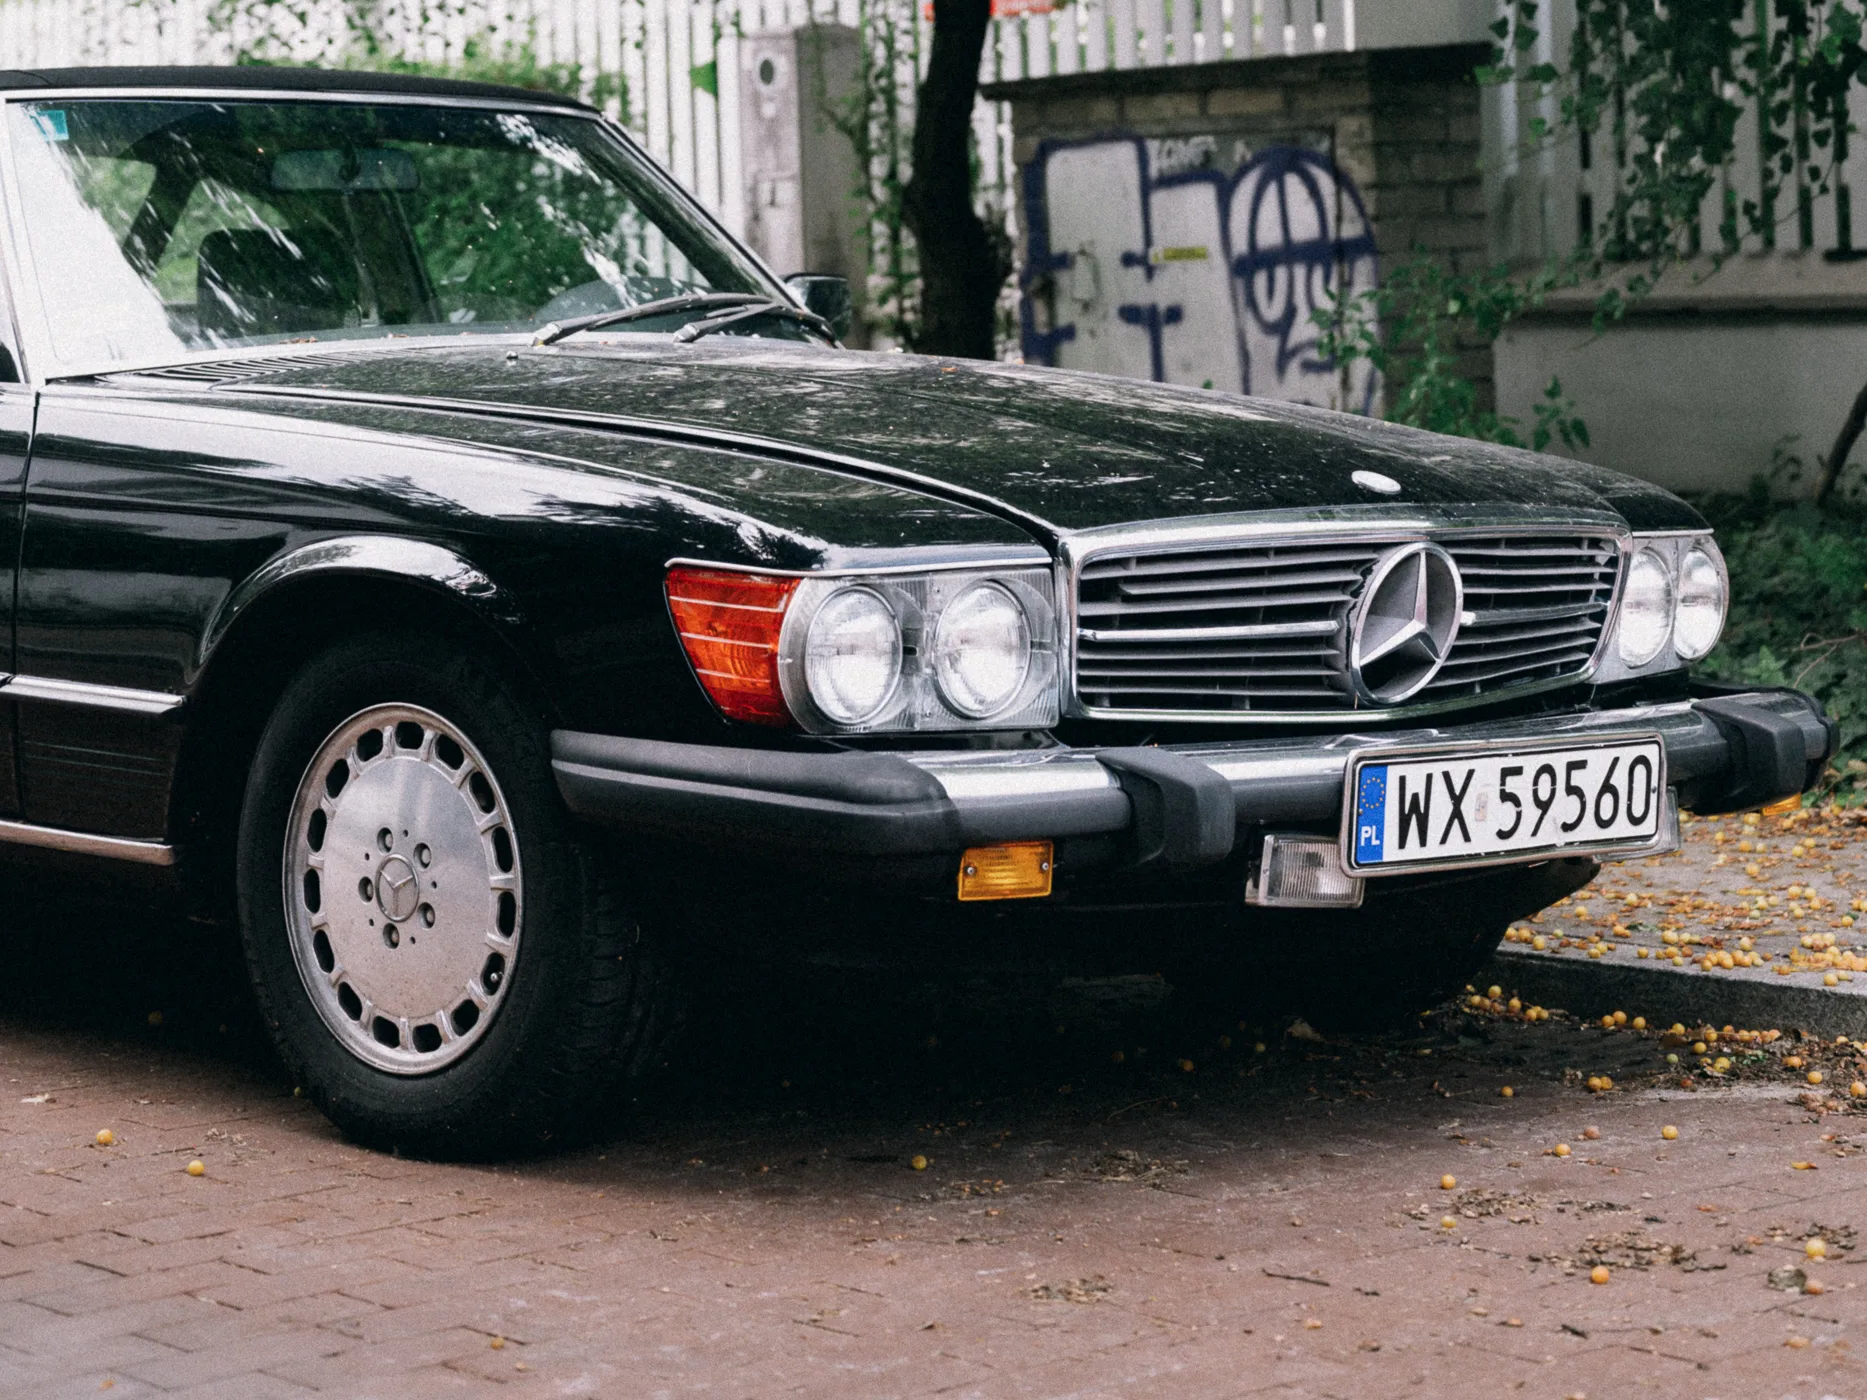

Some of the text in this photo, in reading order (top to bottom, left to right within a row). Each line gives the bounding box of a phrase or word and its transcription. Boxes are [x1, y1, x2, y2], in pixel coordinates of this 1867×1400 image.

[1398, 754, 1652, 850] WX 59560
[1360, 824, 1381, 847] PL
